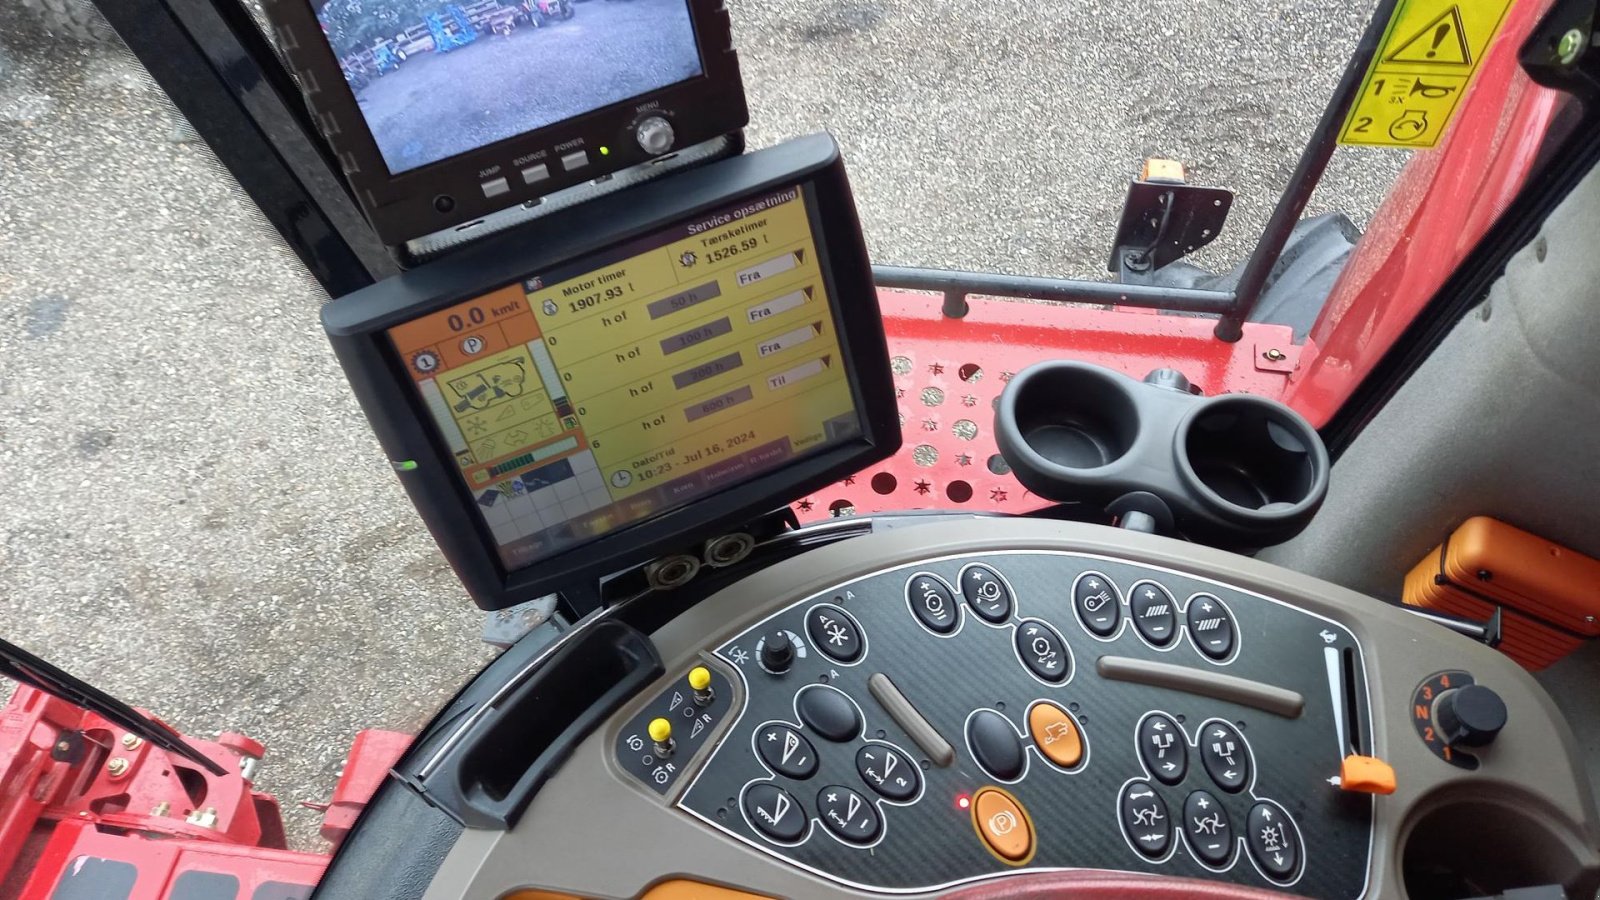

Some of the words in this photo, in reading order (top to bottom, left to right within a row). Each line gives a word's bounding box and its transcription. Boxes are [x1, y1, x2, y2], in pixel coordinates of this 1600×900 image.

[1374, 79, 1386, 96] 1
[635, 100, 660, 114] MENU
[1353, 116, 1373, 133] 2
[554, 137, 585, 153] POWER
[513, 150, 548, 167] SOURCE
[478, 164, 501, 179] JUMP
[687, 213, 731, 235] Service
[734, 188, 797, 219] opsætning
[700, 217, 768, 248] Tærsketimer
[705, 236, 758, 265] 1526.59
[562, 279, 596, 297] Motor
[597, 268, 626, 285] timer
[548, 336, 557, 346] 0
[601, 317, 611, 327] h
[613, 310, 627, 323] of
[691, 292, 698, 302] h
[739, 268, 761, 285] Fra
[568, 285, 623, 313] 1907.93
[448, 307, 485, 332] 0.0
[491, 300, 521, 318] km/t
[563, 371, 573, 382] 0
[615, 353, 625, 363] h
[628, 346, 641, 359] of
[705, 328, 713, 337] h
[750, 306, 772, 322] Fra
[578, 406, 587, 416] 0
[629, 387, 639, 397] h
[641, 381, 654, 393] of
[760, 341, 782, 355] Fra
[642, 421, 651, 430] h
[653, 414, 666, 427] of
[770, 376, 786, 388] Til
[632, 447, 676, 469] Dato/Tid
[637, 462, 673, 481] 10:23
[683, 447, 703, 465] Jul
[726, 430, 756, 448] 2024
[847, 591, 856, 600] A
[830, 669, 840, 680] A
[1440, 674, 1450, 688] 4
[1422, 685, 1433, 700] 3
[702, 713, 712, 723] R
[1415, 704, 1429, 720] N
[1424, 726, 1435, 741] 2
[1443, 745, 1452, 761] 1
[665, 763, 676, 773] R
[896, 776, 907, 787] 2
